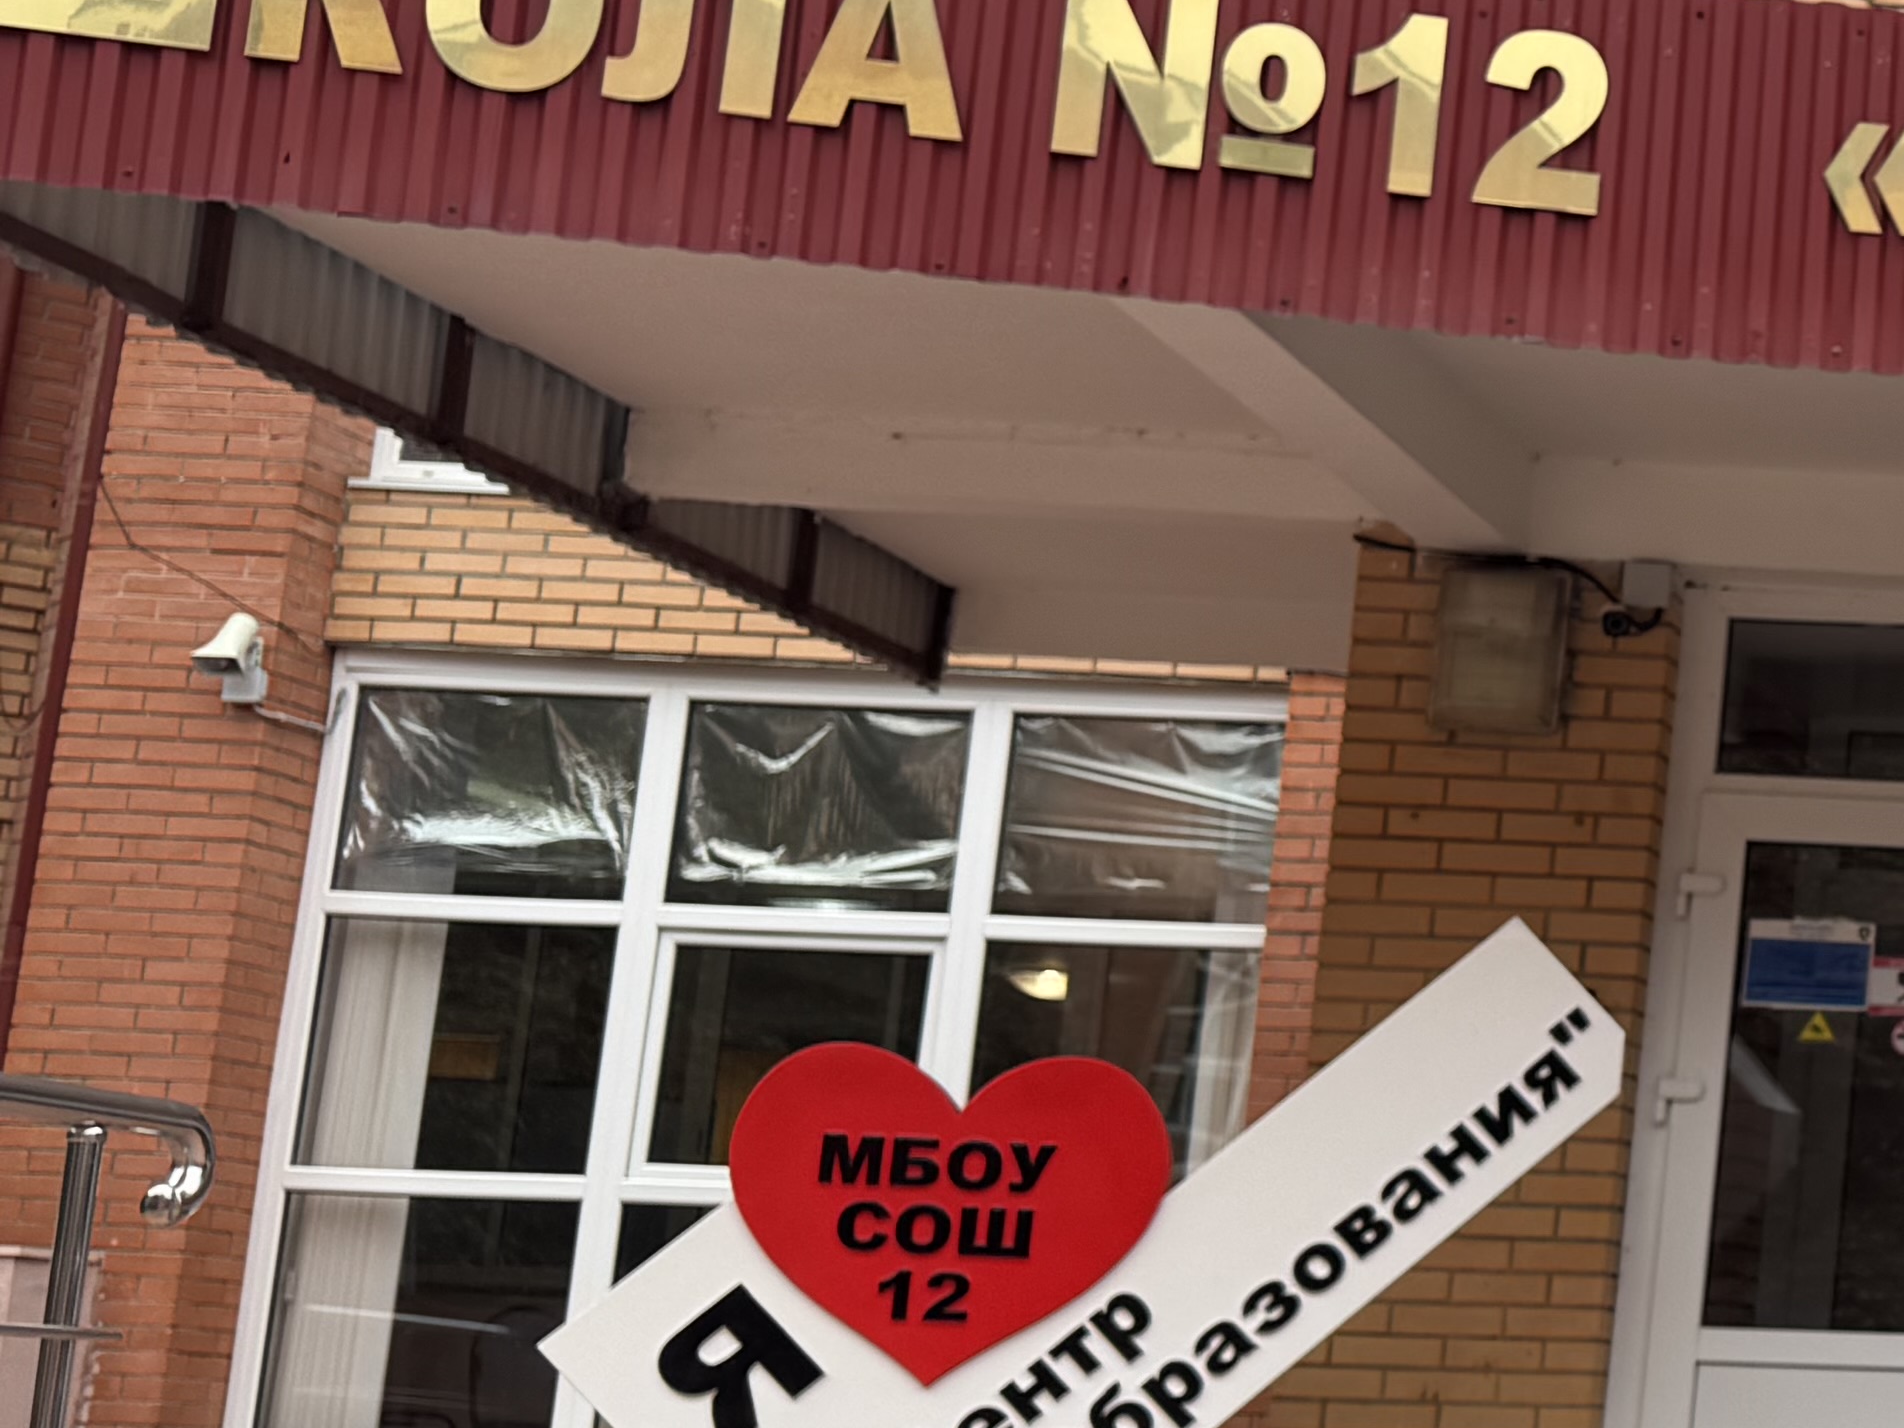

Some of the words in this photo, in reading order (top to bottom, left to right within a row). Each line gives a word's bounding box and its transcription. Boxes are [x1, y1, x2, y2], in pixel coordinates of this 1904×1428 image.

[817, 1132, 1058, 1195] МБОУ
[835, 1200, 1035, 1261] СОШ
[877, 1269, 972, 1324] 12
